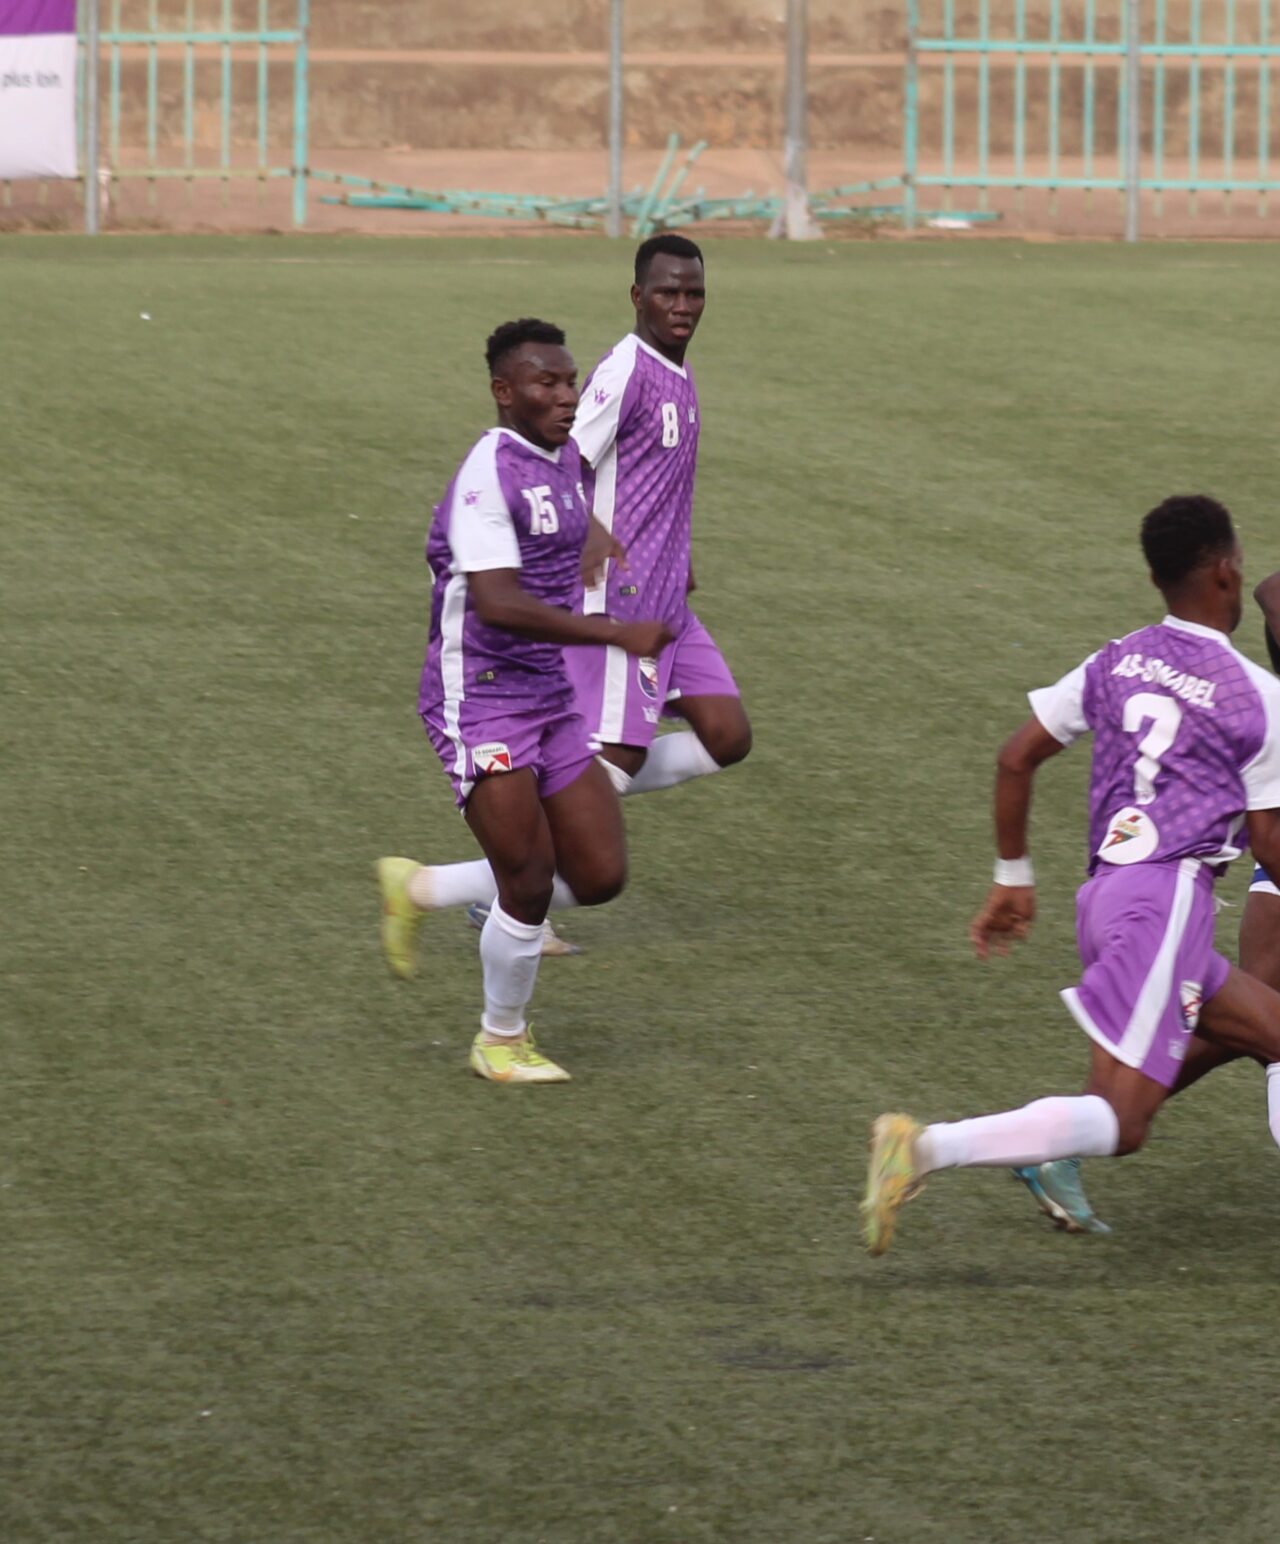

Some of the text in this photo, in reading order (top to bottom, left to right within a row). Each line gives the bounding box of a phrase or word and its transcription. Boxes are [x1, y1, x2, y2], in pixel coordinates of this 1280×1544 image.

[661, 402, 679, 448] 8
[520, 485, 559, 535] 15
[1122, 692, 1183, 805] 7
